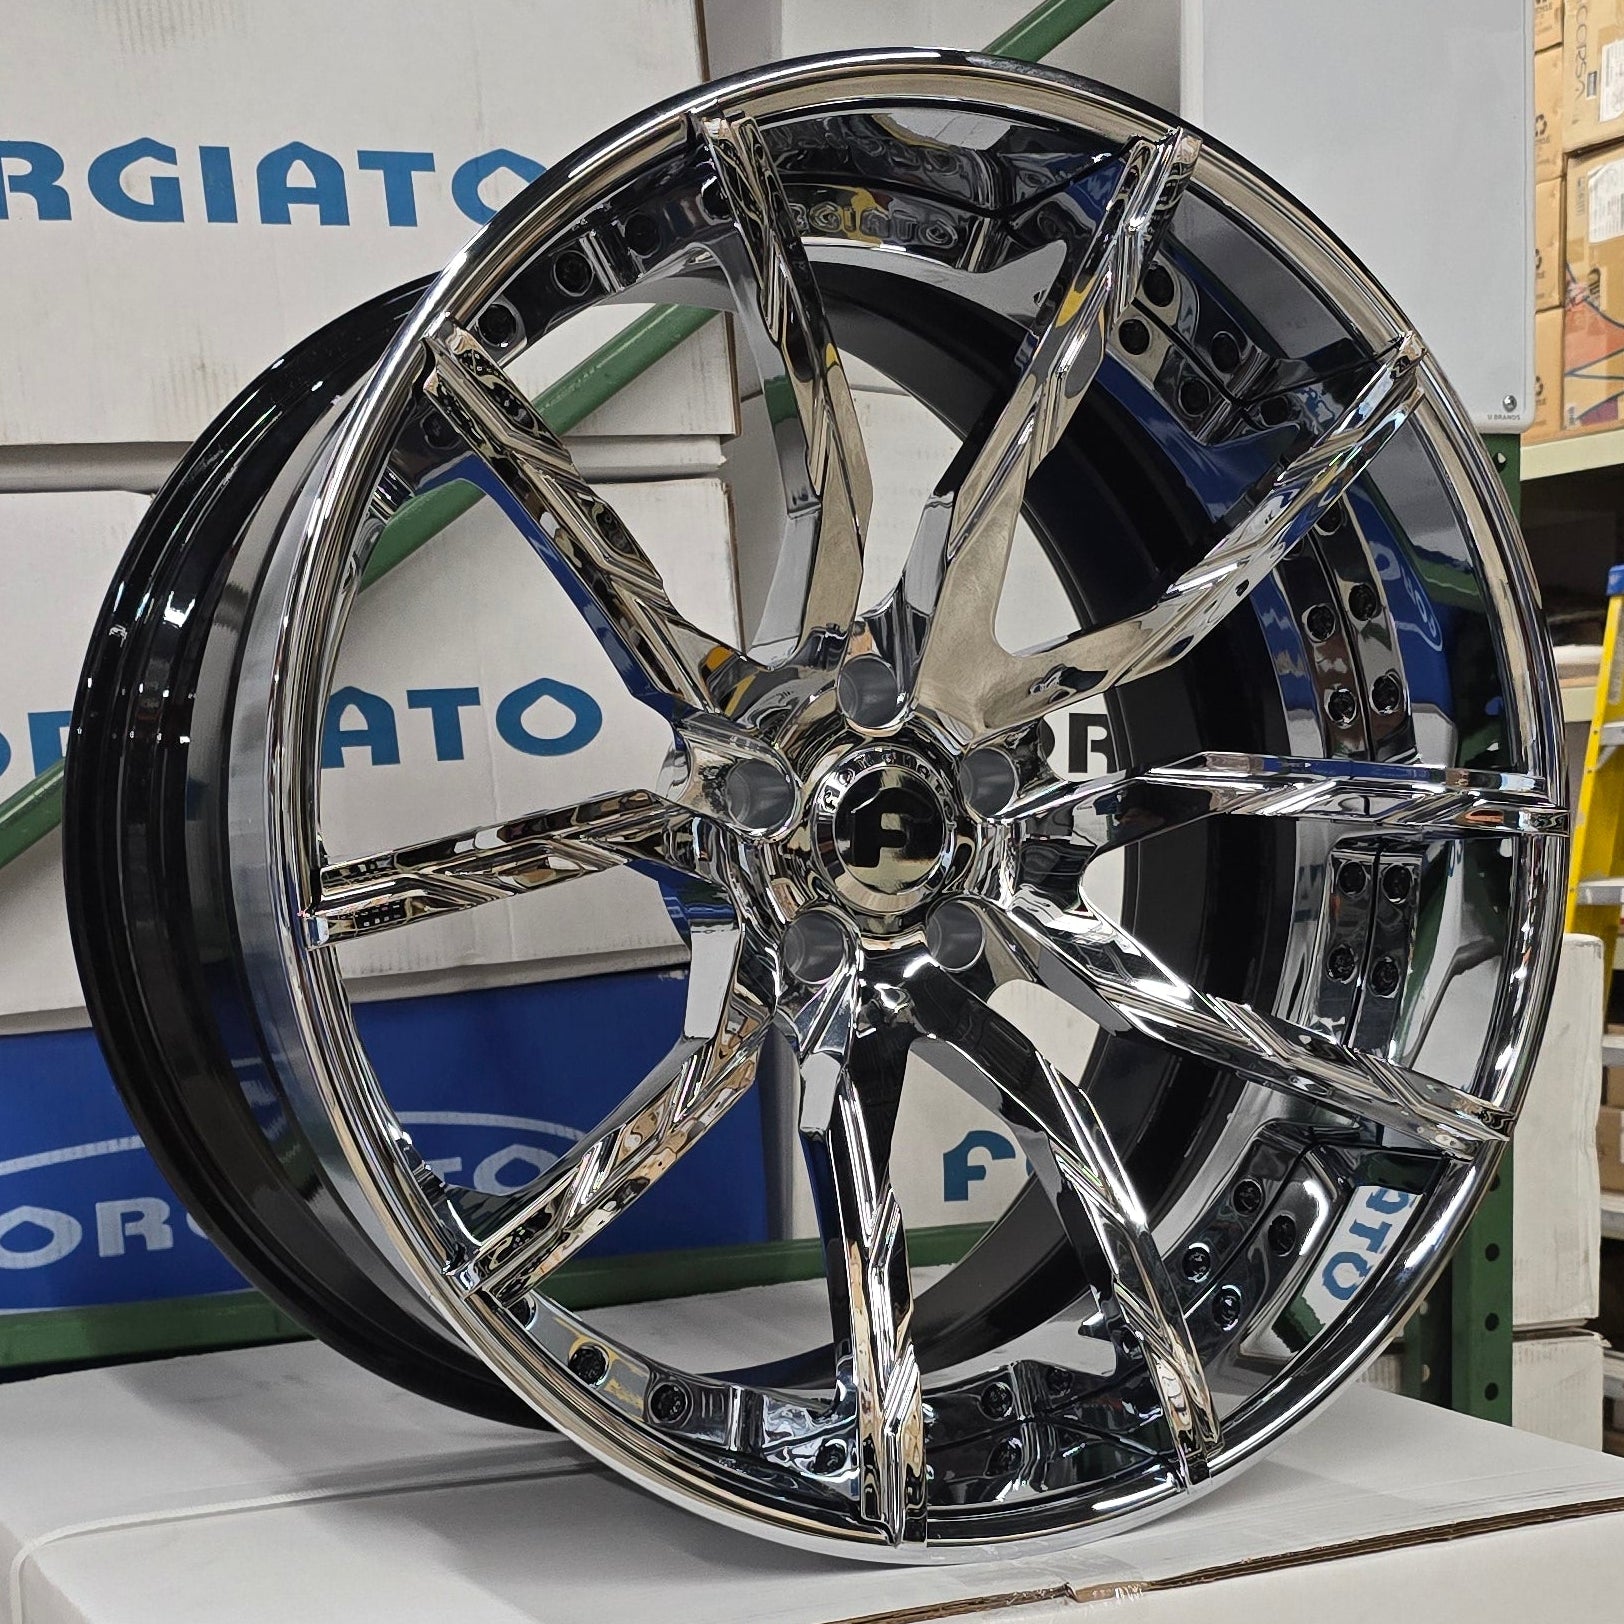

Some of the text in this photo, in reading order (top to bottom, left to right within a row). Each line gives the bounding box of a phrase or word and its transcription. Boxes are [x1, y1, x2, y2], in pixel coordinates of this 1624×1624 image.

[0, 136, 547, 227] RGIATO
[943, 1130, 1034, 1202] F
[0, 1197, 209, 1269] OR
